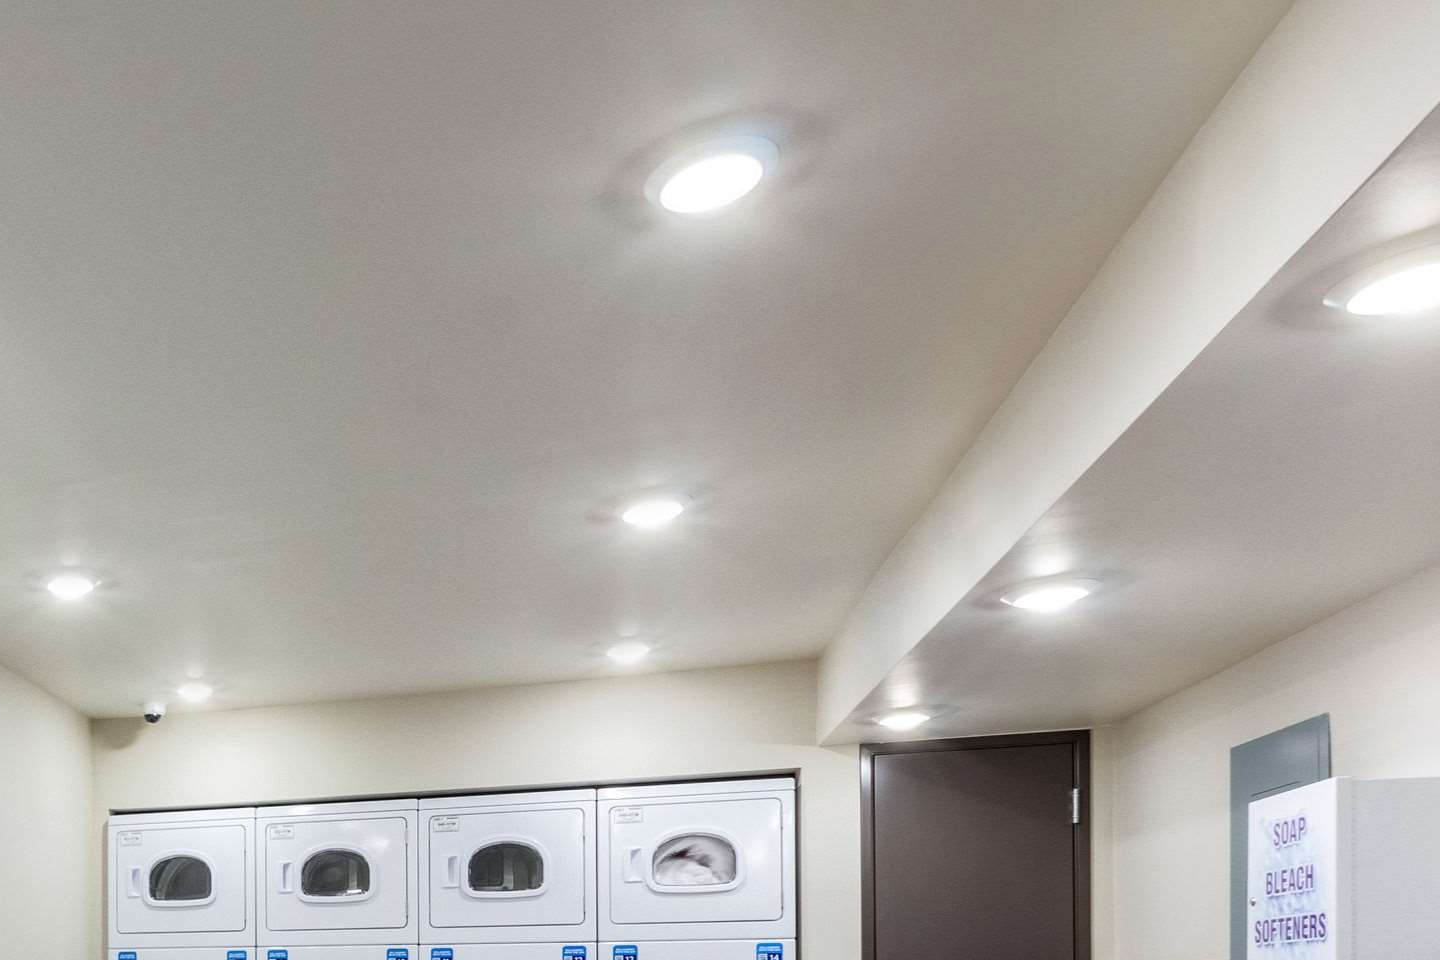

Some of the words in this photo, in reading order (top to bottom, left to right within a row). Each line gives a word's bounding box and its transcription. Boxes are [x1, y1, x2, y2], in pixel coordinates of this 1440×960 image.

[1273, 817, 1306, 846] SOAP
[1265, 864, 1314, 895] BLEACH
[1254, 913, 1327, 943] SOFTENERS
